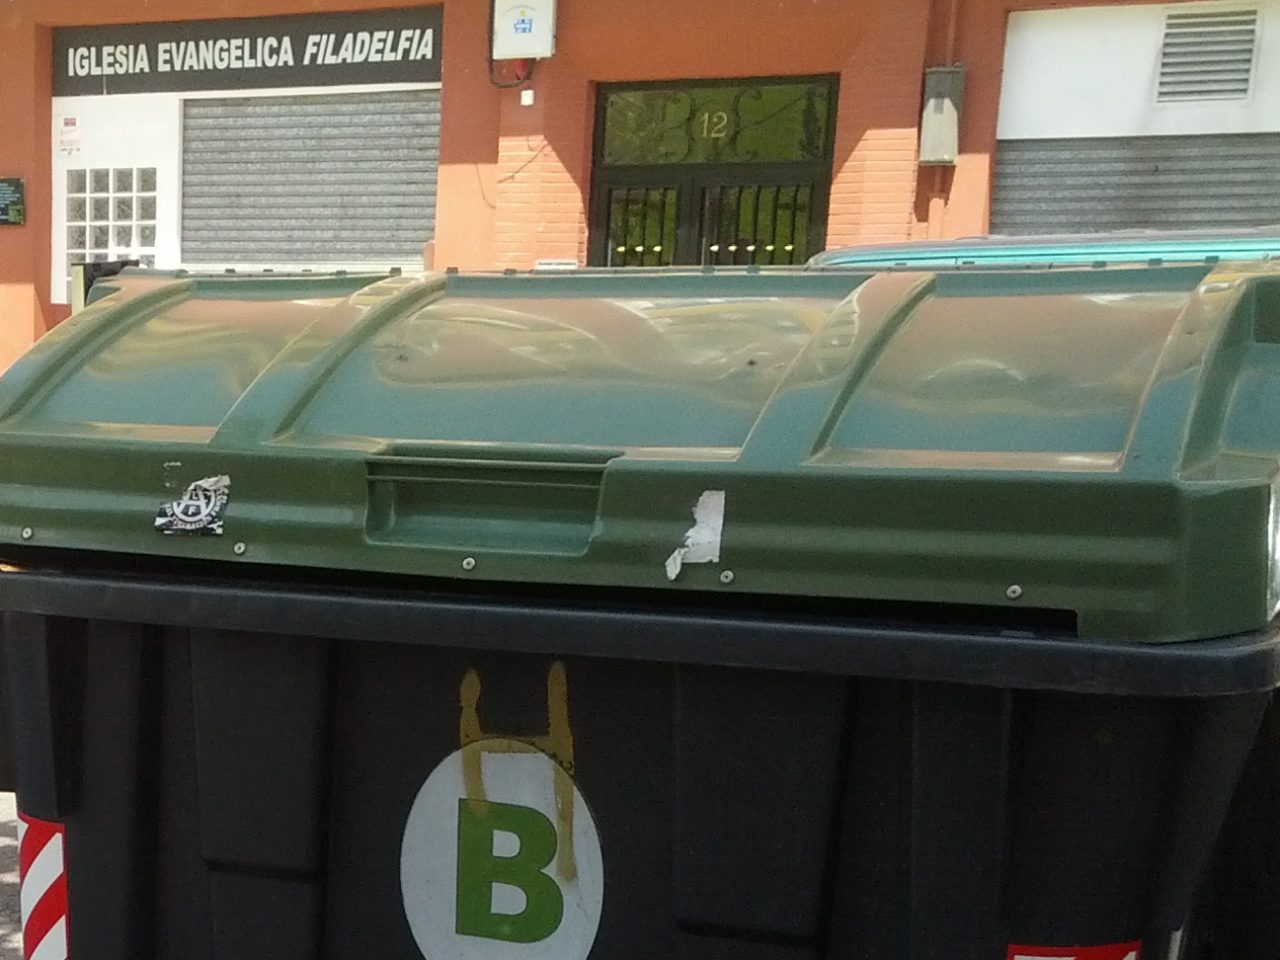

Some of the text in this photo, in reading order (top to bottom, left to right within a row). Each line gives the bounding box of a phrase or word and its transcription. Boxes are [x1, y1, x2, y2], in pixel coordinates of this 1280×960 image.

[67, 28, 433, 77] IGLESIA EVANGELICA FILADELFIA
[700, 111, 728, 138] 12
[455, 798, 564, 944] B
